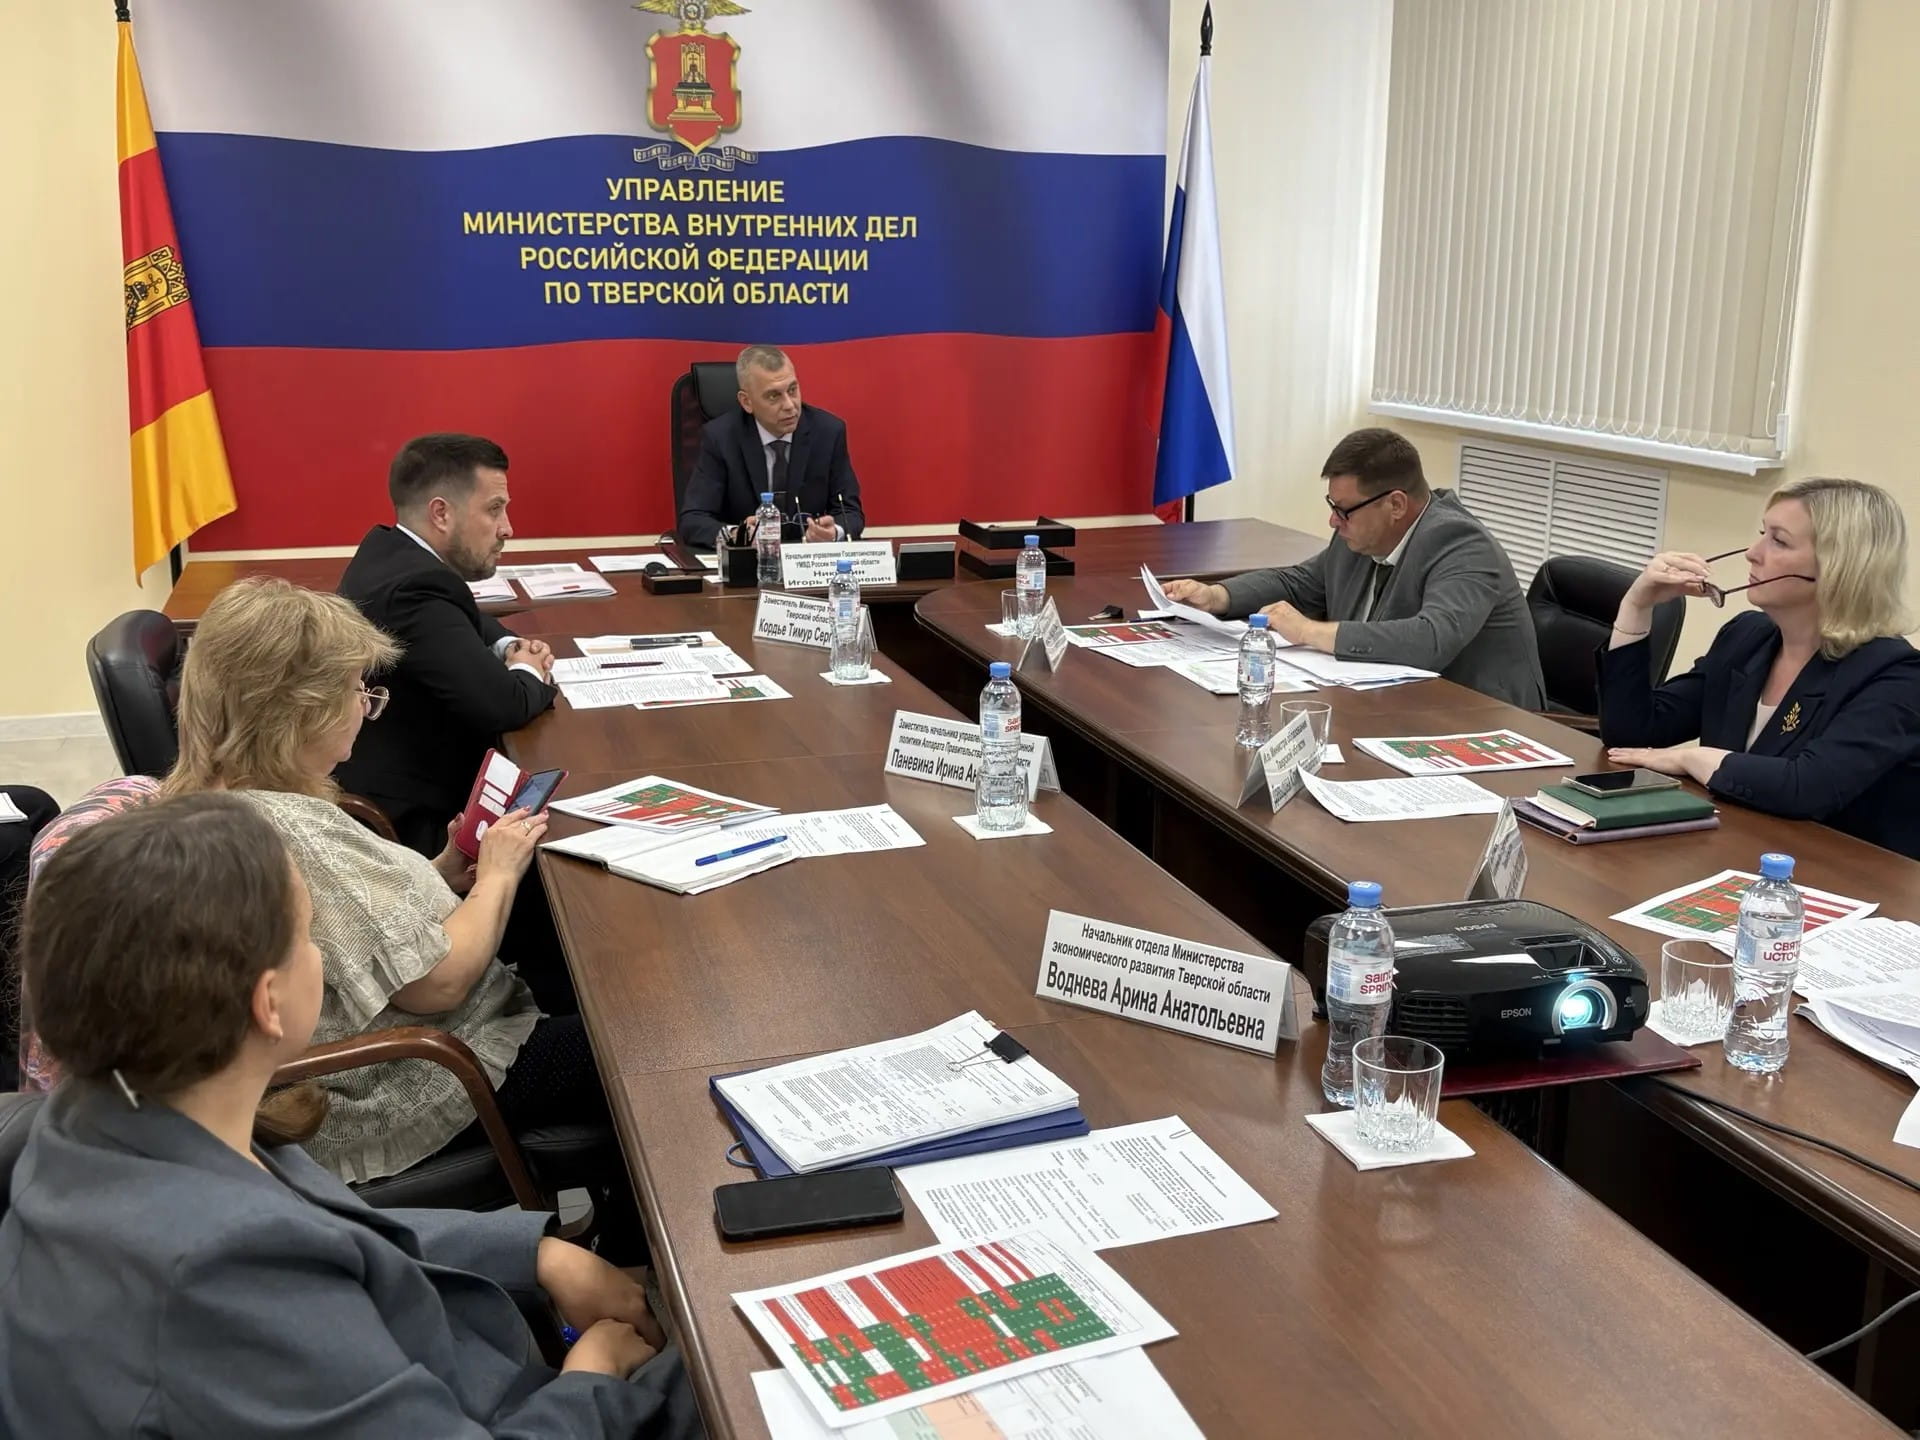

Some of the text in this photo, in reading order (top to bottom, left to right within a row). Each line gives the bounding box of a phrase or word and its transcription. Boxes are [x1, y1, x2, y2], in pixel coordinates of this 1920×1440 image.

[606, 178, 785, 203] УПРАВЛЕНИЕ
[462, 211, 918, 242] МИНИСТЕРСТВА ВНУТРЕННИХ ДЕЛ
[520, 242, 870, 275] РОССИЙСКОЙ ФЕДЕРАЦИИ
[544, 276, 850, 305] ПО ТВЕРСКОЙ ОБЛАСТИ
[763, 594, 798, 608] Заместитель
[798, 600, 827, 612] Министра
[786, 609, 811, 621] Тверской
[759, 617, 787, 637] Кордье
[789, 622, 812, 642] Тимур
[898, 718, 930, 734] Заместитель
[930, 724, 959, 740] начальника
[898, 734, 921, 746] политики
[921, 737, 945, 751] Аппарата
[891, 748, 934, 774] Паневина
[935, 757, 964, 781] Ирина
[1081, 922, 1245, 974] Начальник отдела Министерства
[1051, 940, 1271, 1003] экономического развития Тверской области
[1360, 981, 1392, 994] SPRIN
[1046, 960, 1265, 1041] Воднева Арина Анатольевна
[1501, 1007, 1532, 1019] EPSON
